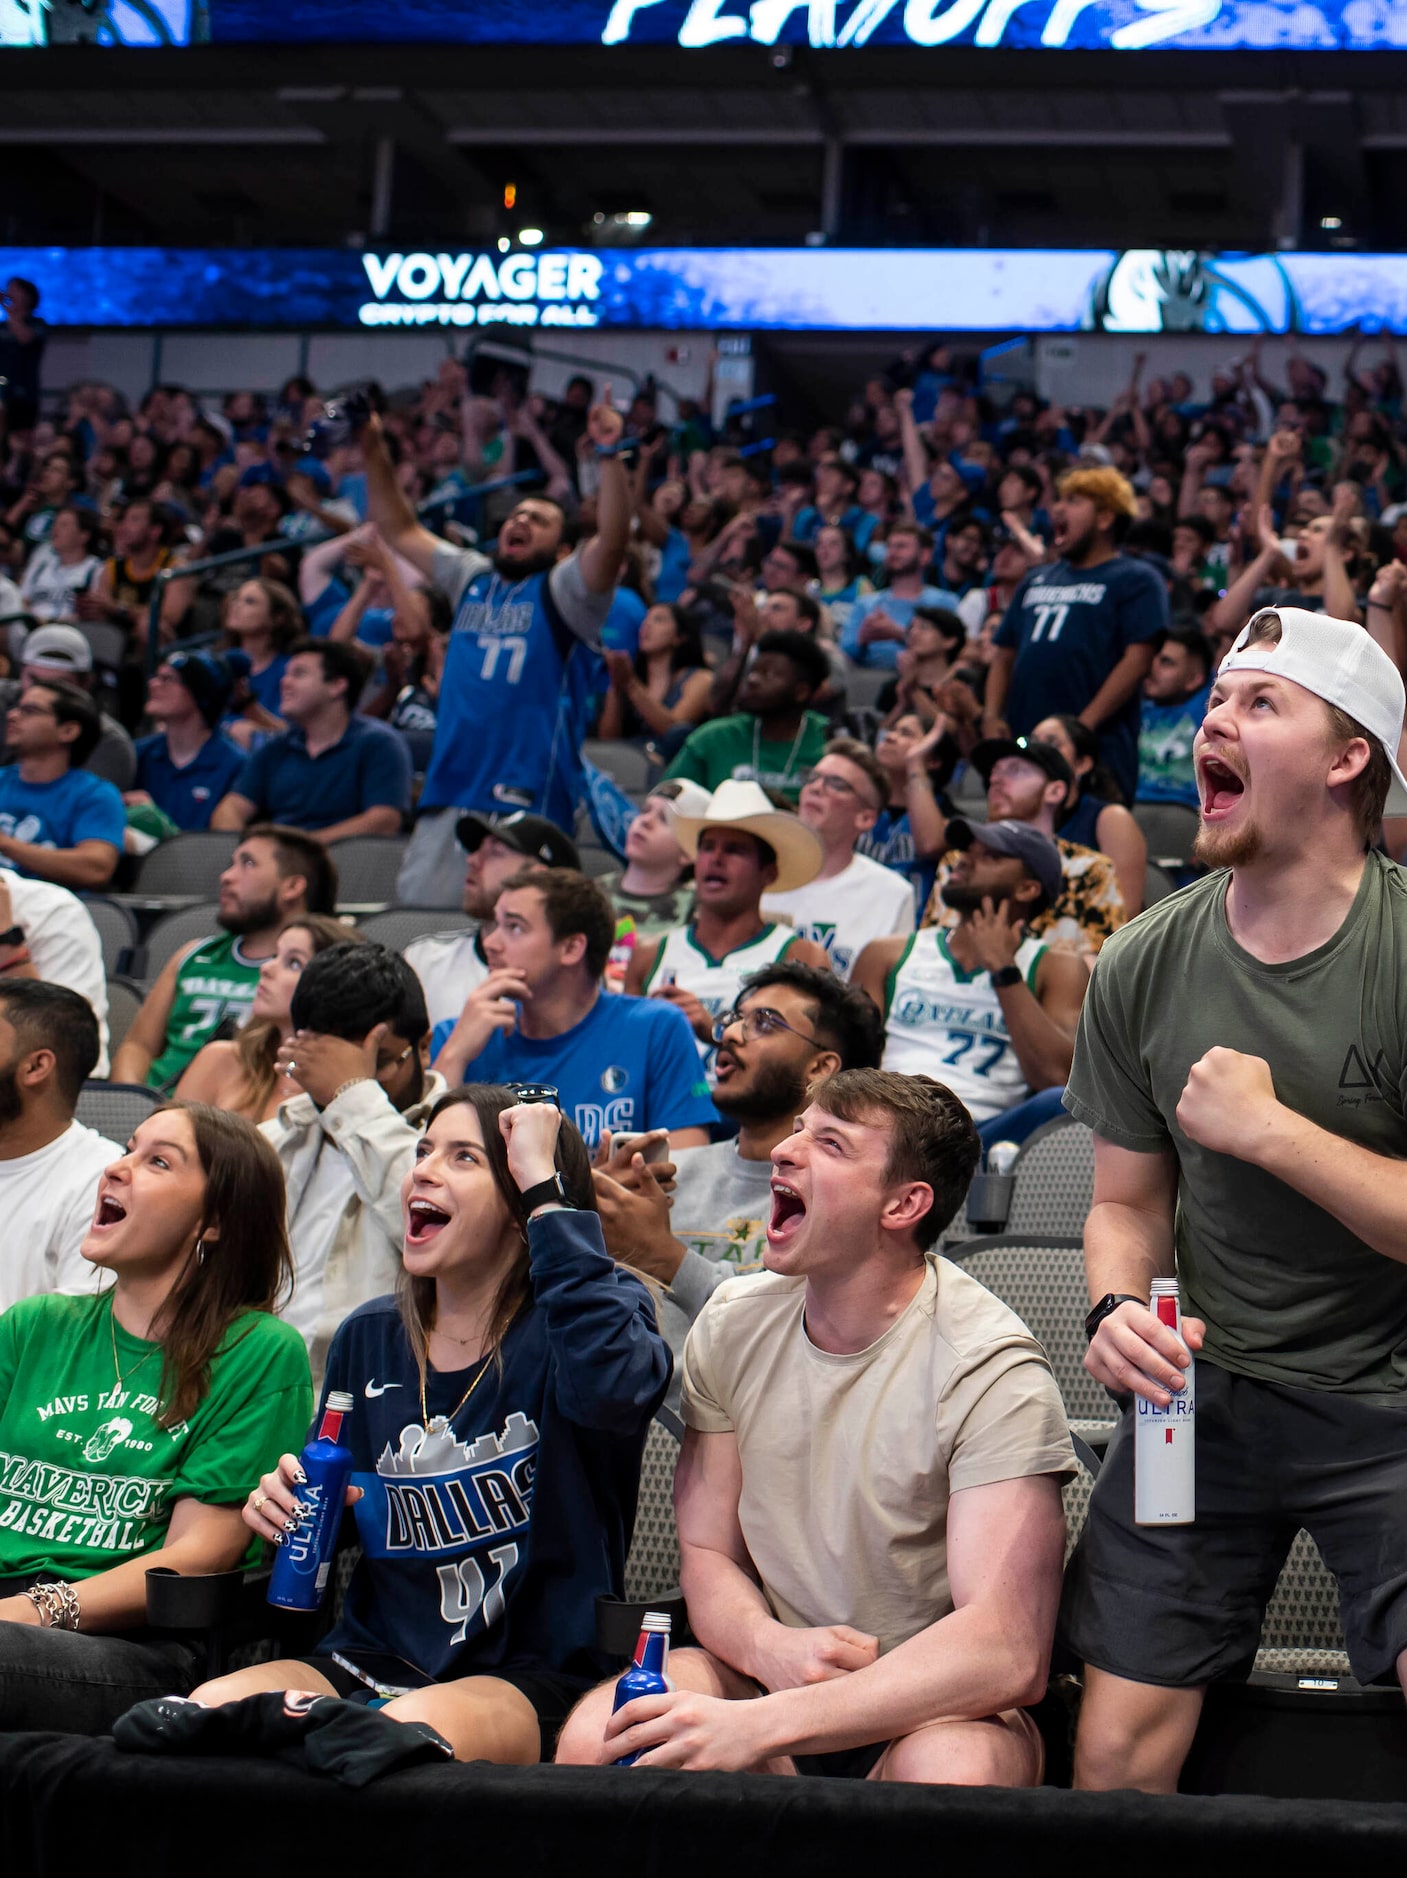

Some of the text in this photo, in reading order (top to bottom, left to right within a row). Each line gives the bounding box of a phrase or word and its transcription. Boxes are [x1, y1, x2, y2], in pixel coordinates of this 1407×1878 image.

[361, 252, 604, 301] VOYAGER
[1030, 604, 1070, 642] 77
[477, 635, 528, 685] 77
[942, 1028, 1008, 1077] 77
[36, 1394, 89, 1422] MAVS
[97, 1391, 130, 1410] FAN
[1138, 1400, 1195, 1415] ULTRA
[55, 1429, 153, 1452] EST. 1980
[0, 1499, 147, 1551] BASKETBALL
